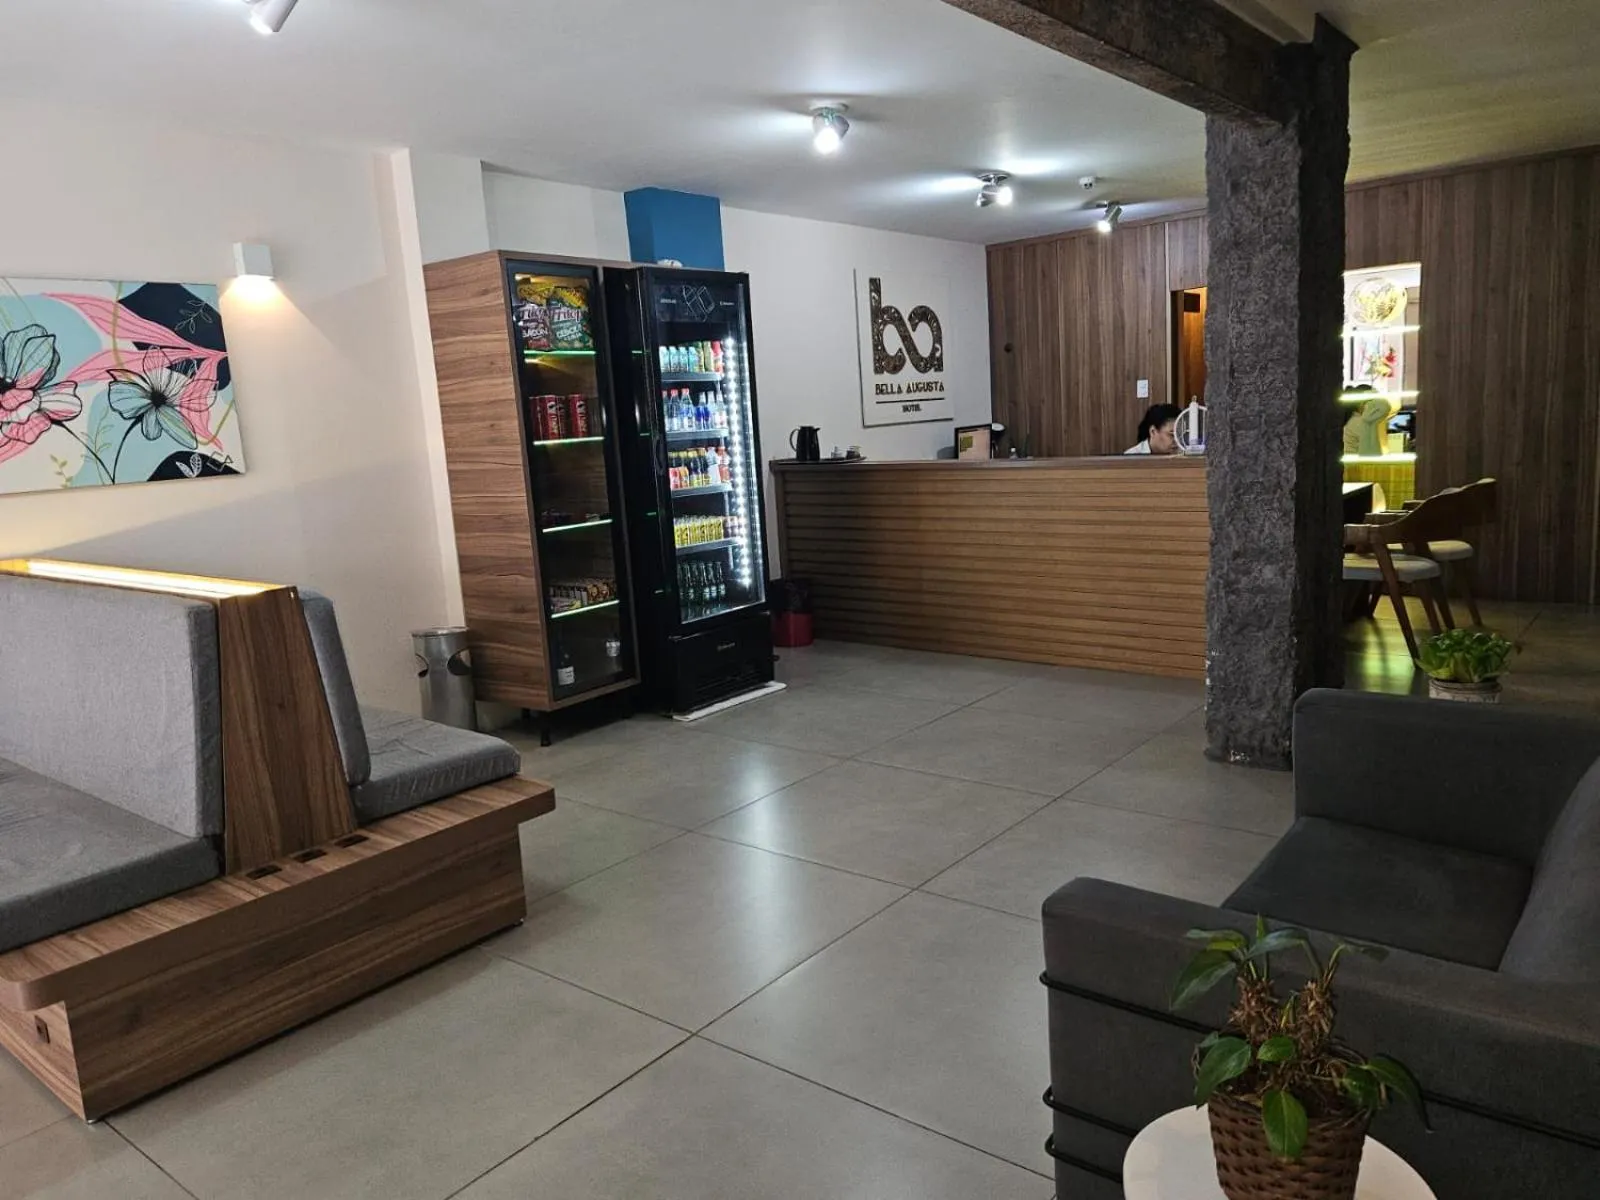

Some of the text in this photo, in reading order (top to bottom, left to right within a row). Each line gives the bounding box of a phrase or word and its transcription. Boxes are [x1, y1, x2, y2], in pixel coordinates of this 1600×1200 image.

[875, 381, 945, 395] BELLA AUGUSTA
[902, 403, 921, 413] HOTEL
